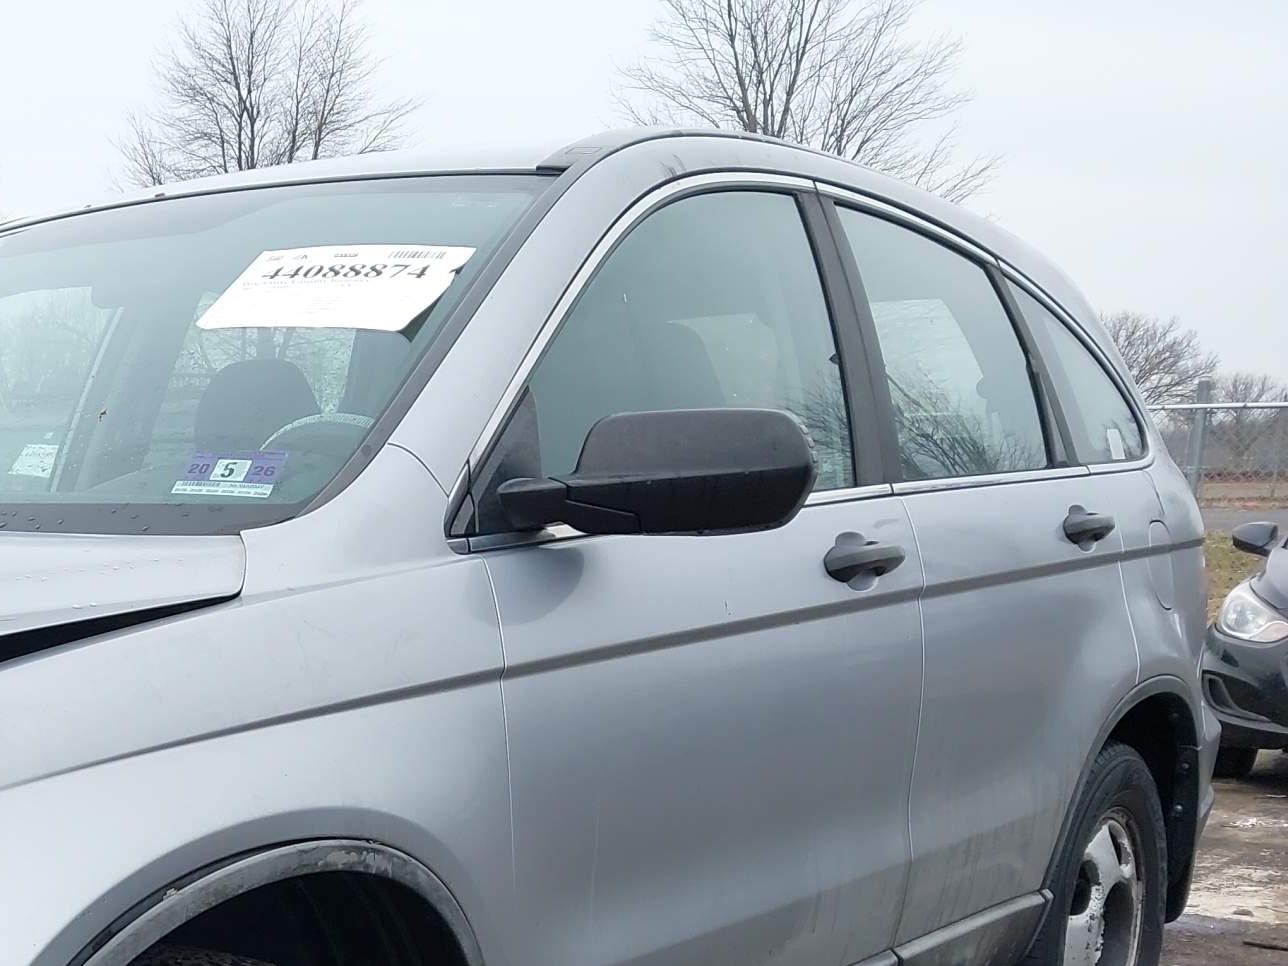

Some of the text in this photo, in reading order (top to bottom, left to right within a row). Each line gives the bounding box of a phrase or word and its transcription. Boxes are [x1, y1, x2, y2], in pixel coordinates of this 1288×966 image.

[261, 263, 430, 280] 44088874
[187, 462, 276, 478] 20 5 26
